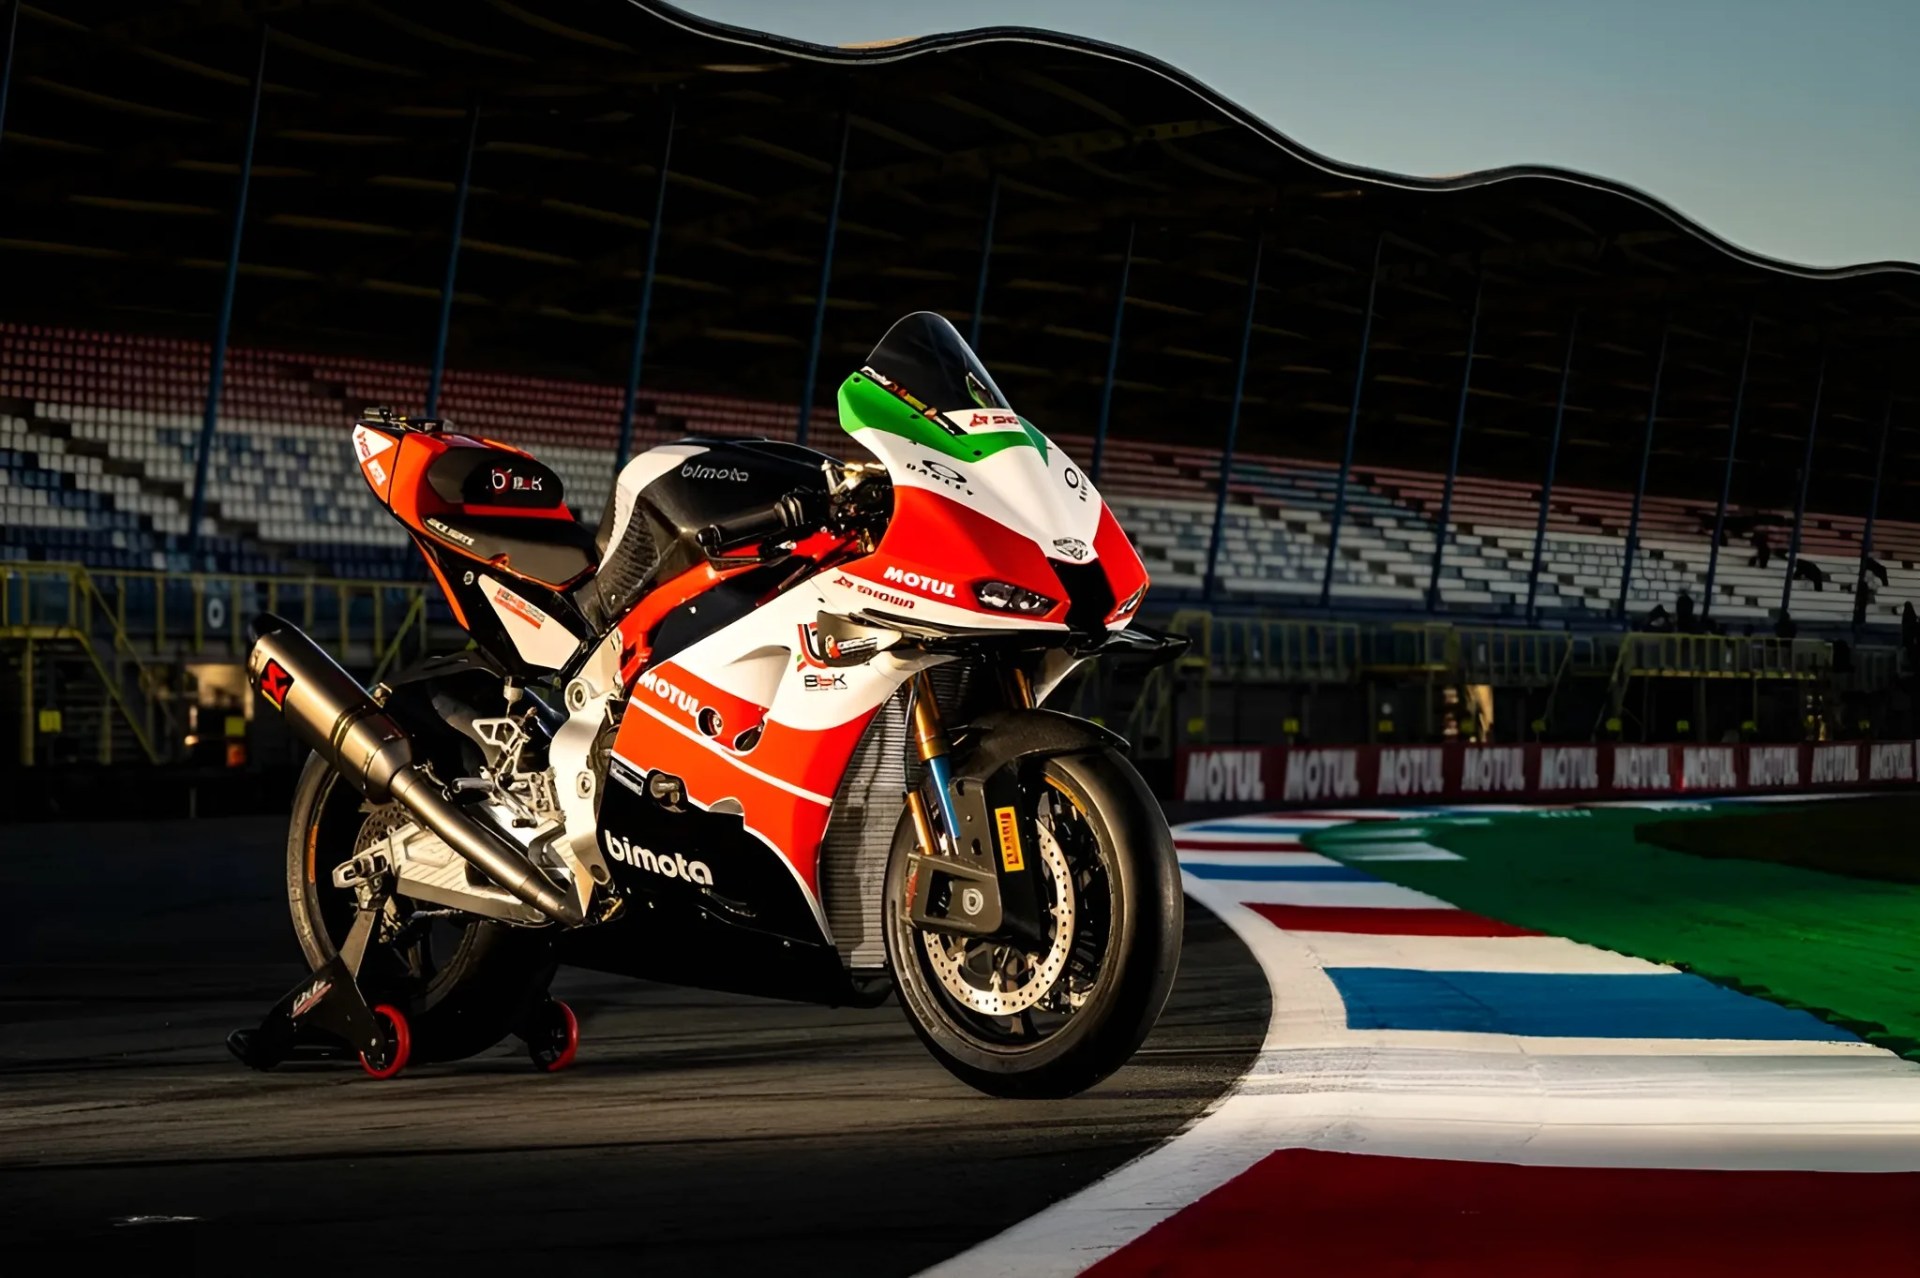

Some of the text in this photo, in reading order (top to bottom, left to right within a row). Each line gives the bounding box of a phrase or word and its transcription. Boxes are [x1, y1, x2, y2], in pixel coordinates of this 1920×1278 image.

[883, 566, 956, 598] MOTUL
[637, 671, 702, 717] MOTUL
[1184, 751, 1265, 802] MOTUL
[1283, 749, 1360, 801] MOTUL
[1377, 748, 1444, 796] MOTUL
[1461, 747, 1525, 791] MOTUL
[1538, 747, 1599, 791] MOTUL
[1612, 747, 1671, 789] MOTUL
[604, 829, 714, 886] bimota
